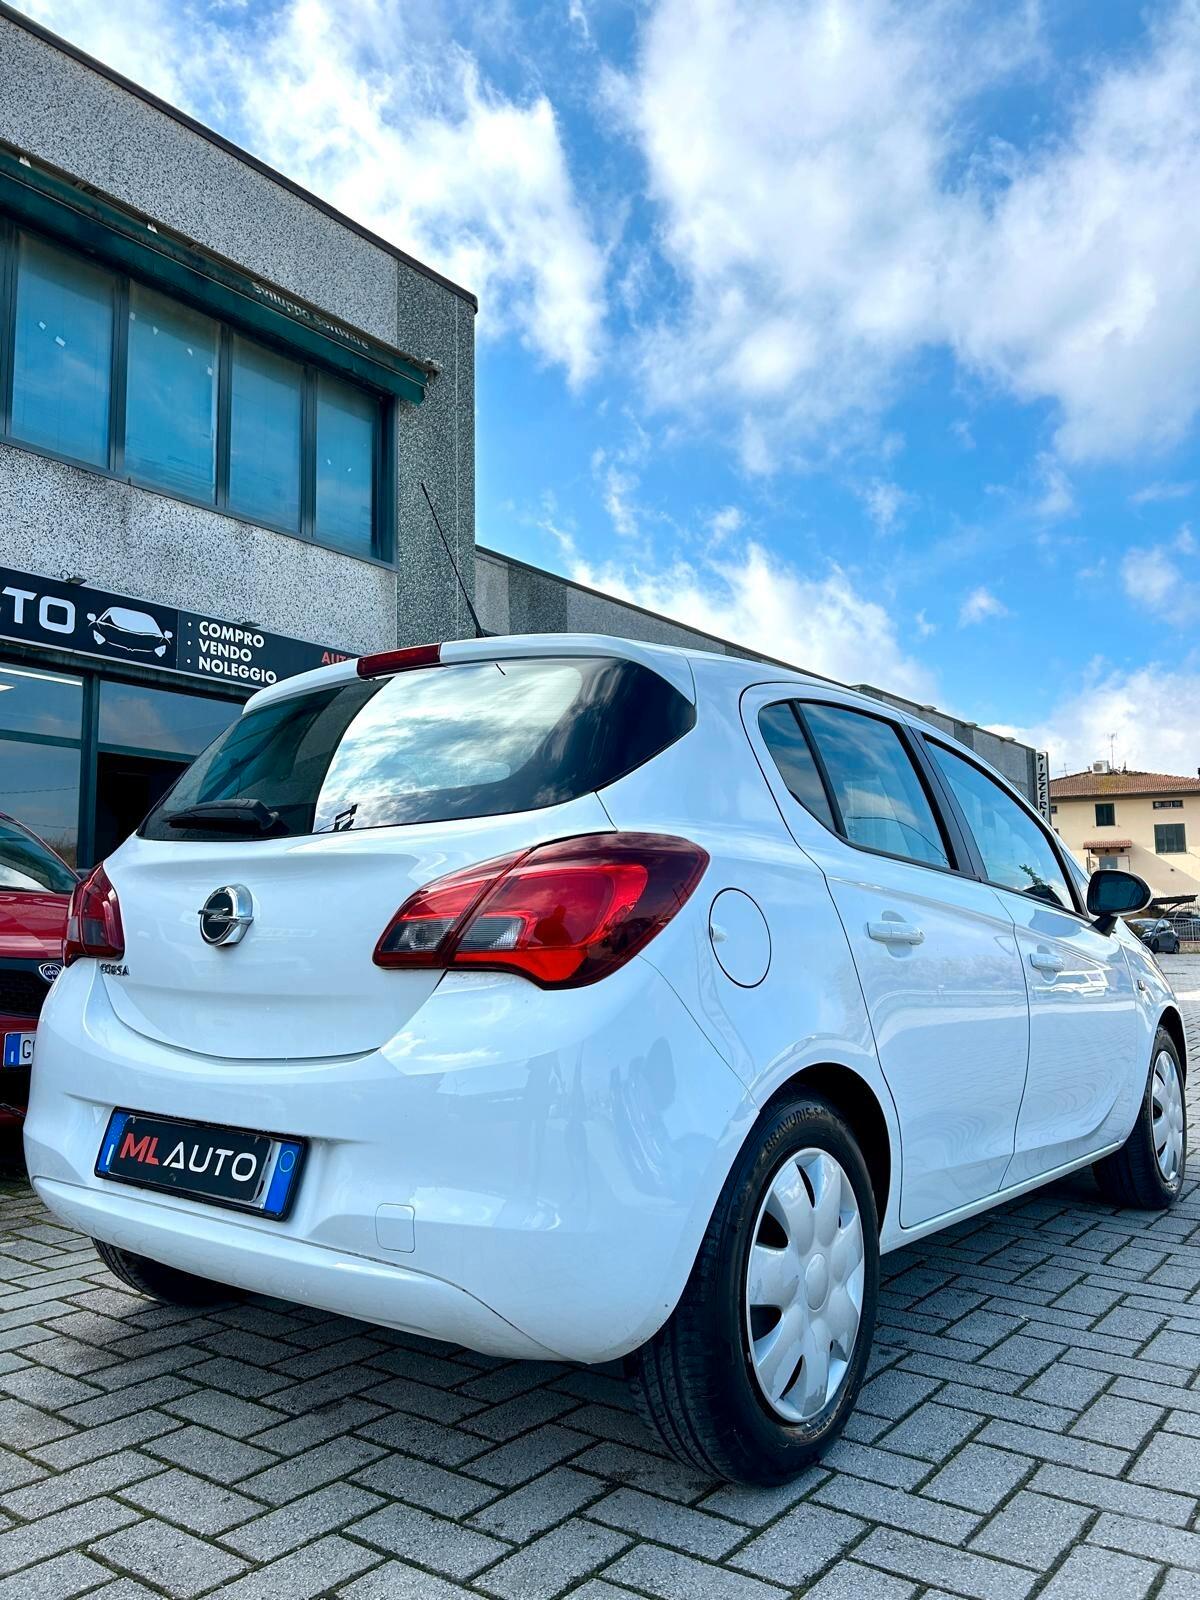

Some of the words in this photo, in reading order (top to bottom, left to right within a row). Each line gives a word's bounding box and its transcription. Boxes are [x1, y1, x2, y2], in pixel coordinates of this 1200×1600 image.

[0, 586, 76, 634] TO
[199, 621, 265, 648] COMPRO
[199, 638, 252, 663] VENDO
[321, 651, 351, 664] AUT
[199, 656, 277, 684] NOLEGGIO
[1037, 753, 1047, 818] PIZZERI
